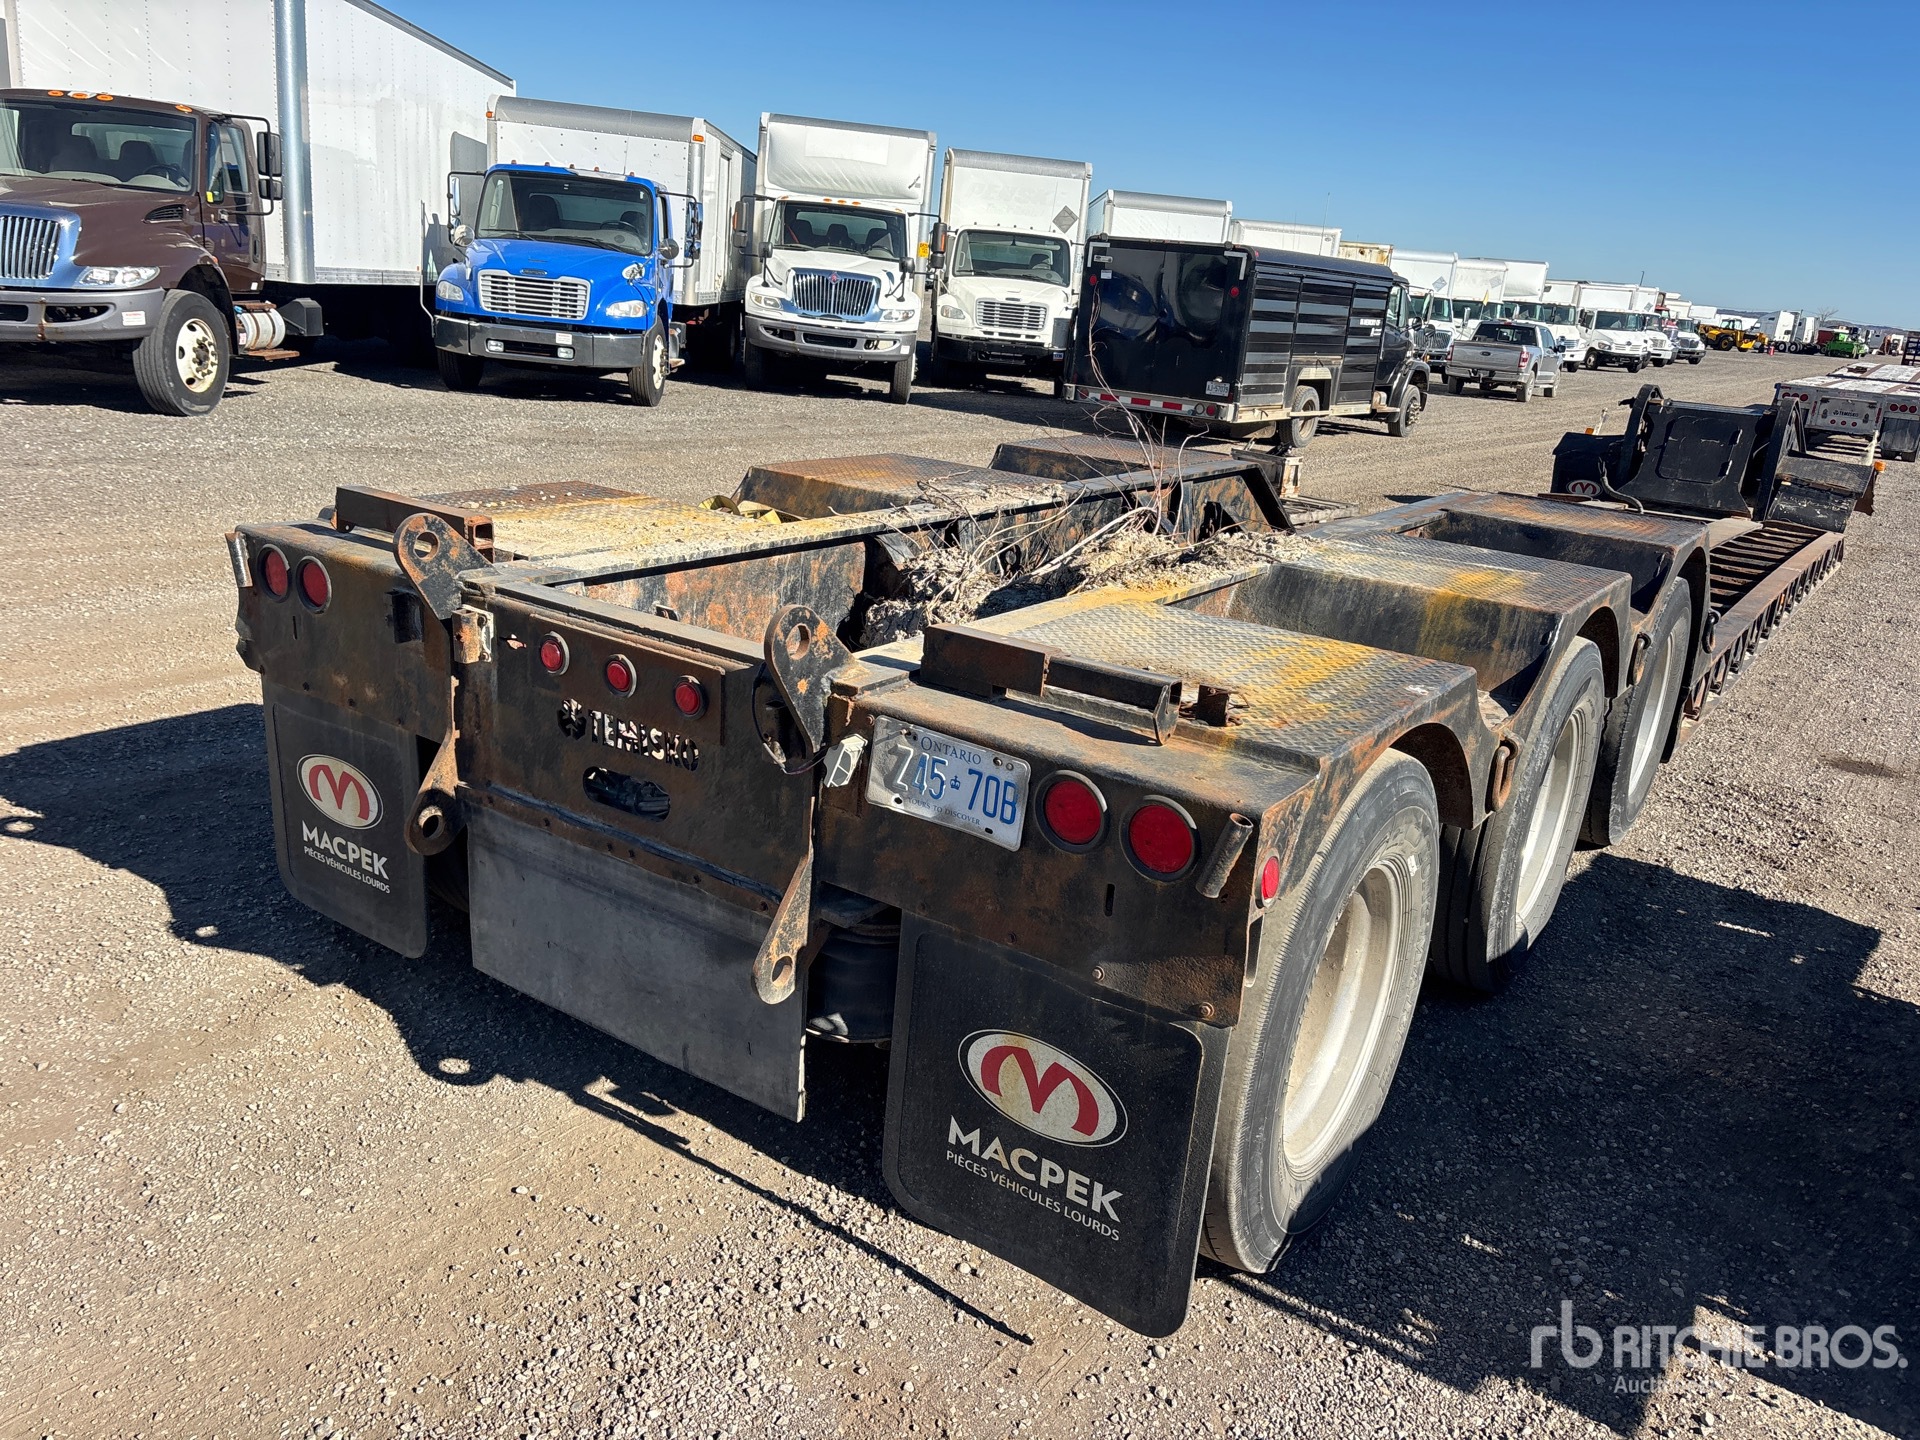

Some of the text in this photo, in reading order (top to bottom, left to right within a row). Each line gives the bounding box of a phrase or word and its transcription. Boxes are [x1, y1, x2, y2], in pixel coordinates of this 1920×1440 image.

[588, 709, 699, 771] TEMISKO
[921, 736, 981, 765] ONTARIO
[886, 744, 1019, 825] Z45 70B
[907, 797, 980, 825] YOURS TO DISCOVER
[302, 820, 389, 880] MACPEK
[304, 845, 390, 894] PIÈCES VÉHICULES LOURDS
[946, 1150, 1120, 1241] PIÈCES VÉHICULES LOURDS
[948, 1115, 1123, 1222] MACPEK
